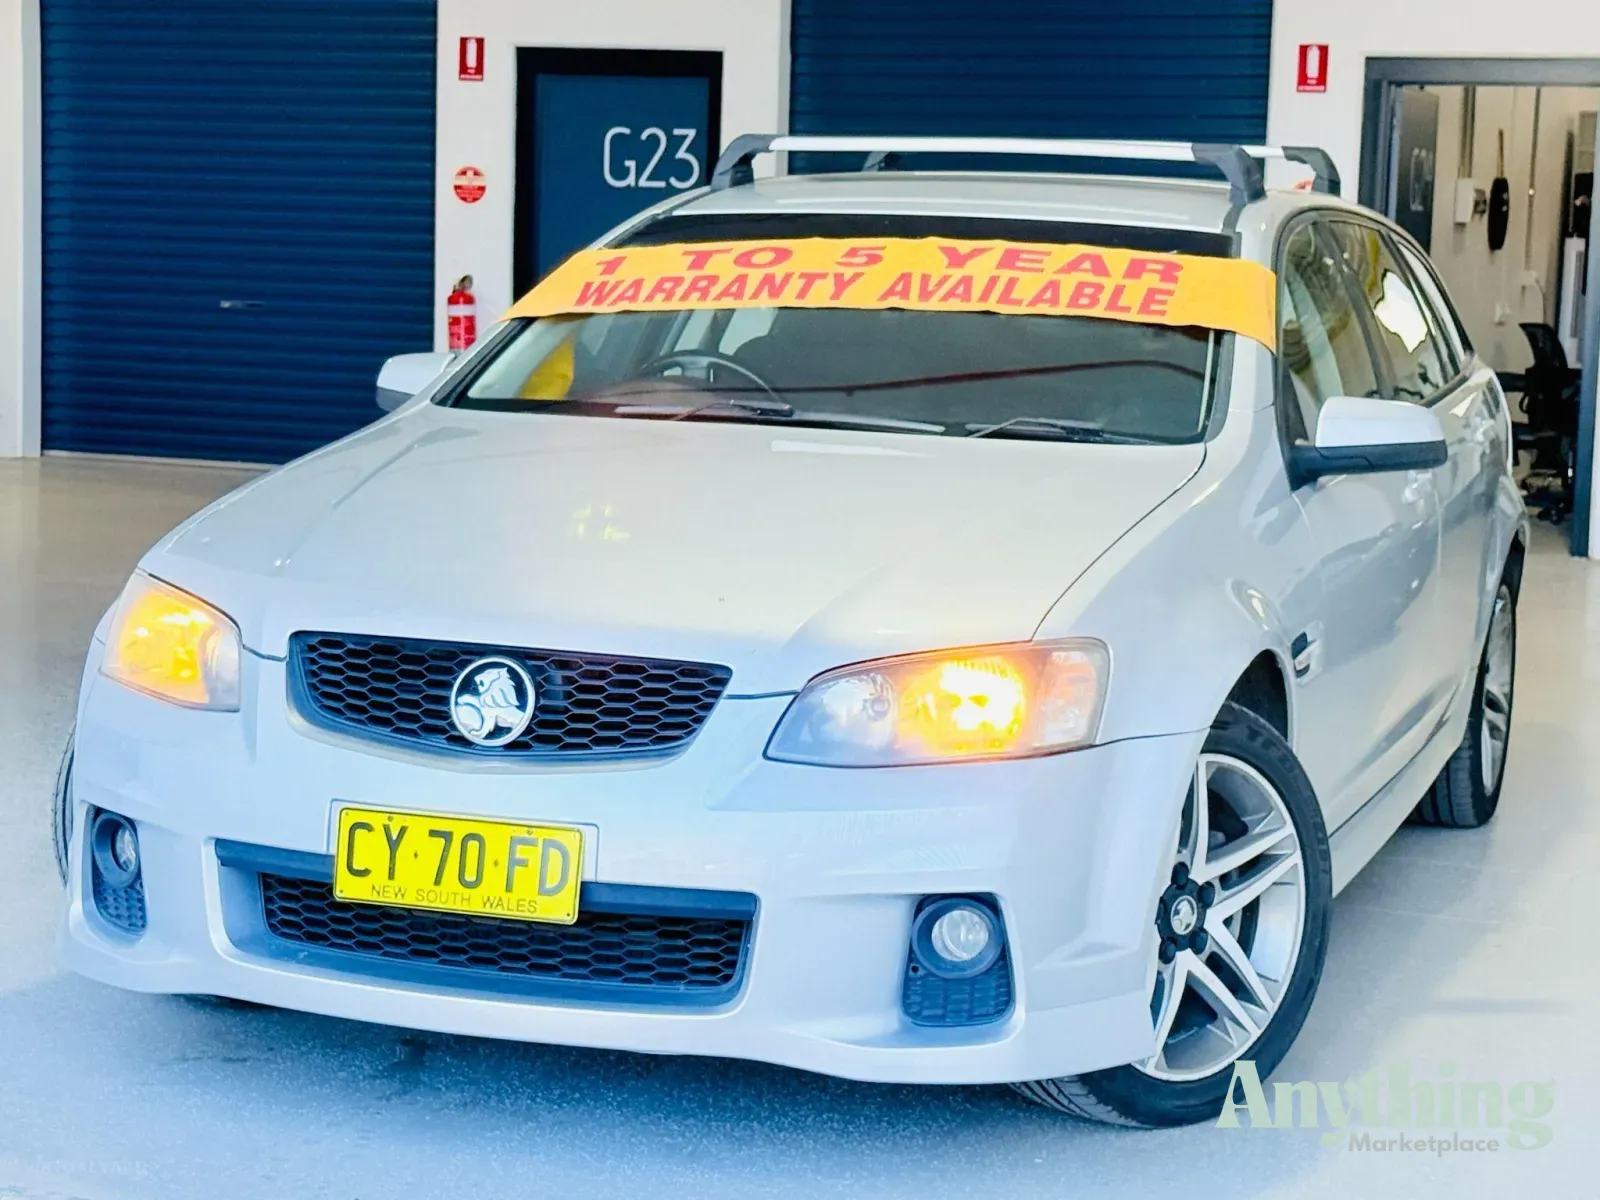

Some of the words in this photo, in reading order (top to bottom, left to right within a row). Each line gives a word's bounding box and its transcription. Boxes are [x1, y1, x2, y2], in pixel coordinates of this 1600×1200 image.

[603, 126, 700, 189] G23
[596, 255, 627, 275] 1
[680, 246, 794, 271] TO
[835, 246, 886, 268] 5
[937, 245, 1184, 285] YEAR
[573, 271, 865, 307] WARRANTY
[876, 271, 1176, 317] AVAILABLE
[345, 822, 408, 881] CY
[428, 829, 487, 889] 70
[505, 835, 571, 897] FD
[371, 883, 407, 900] NEW
[415, 888, 472, 906] SOUTH
[481, 895, 538, 914] WALES
